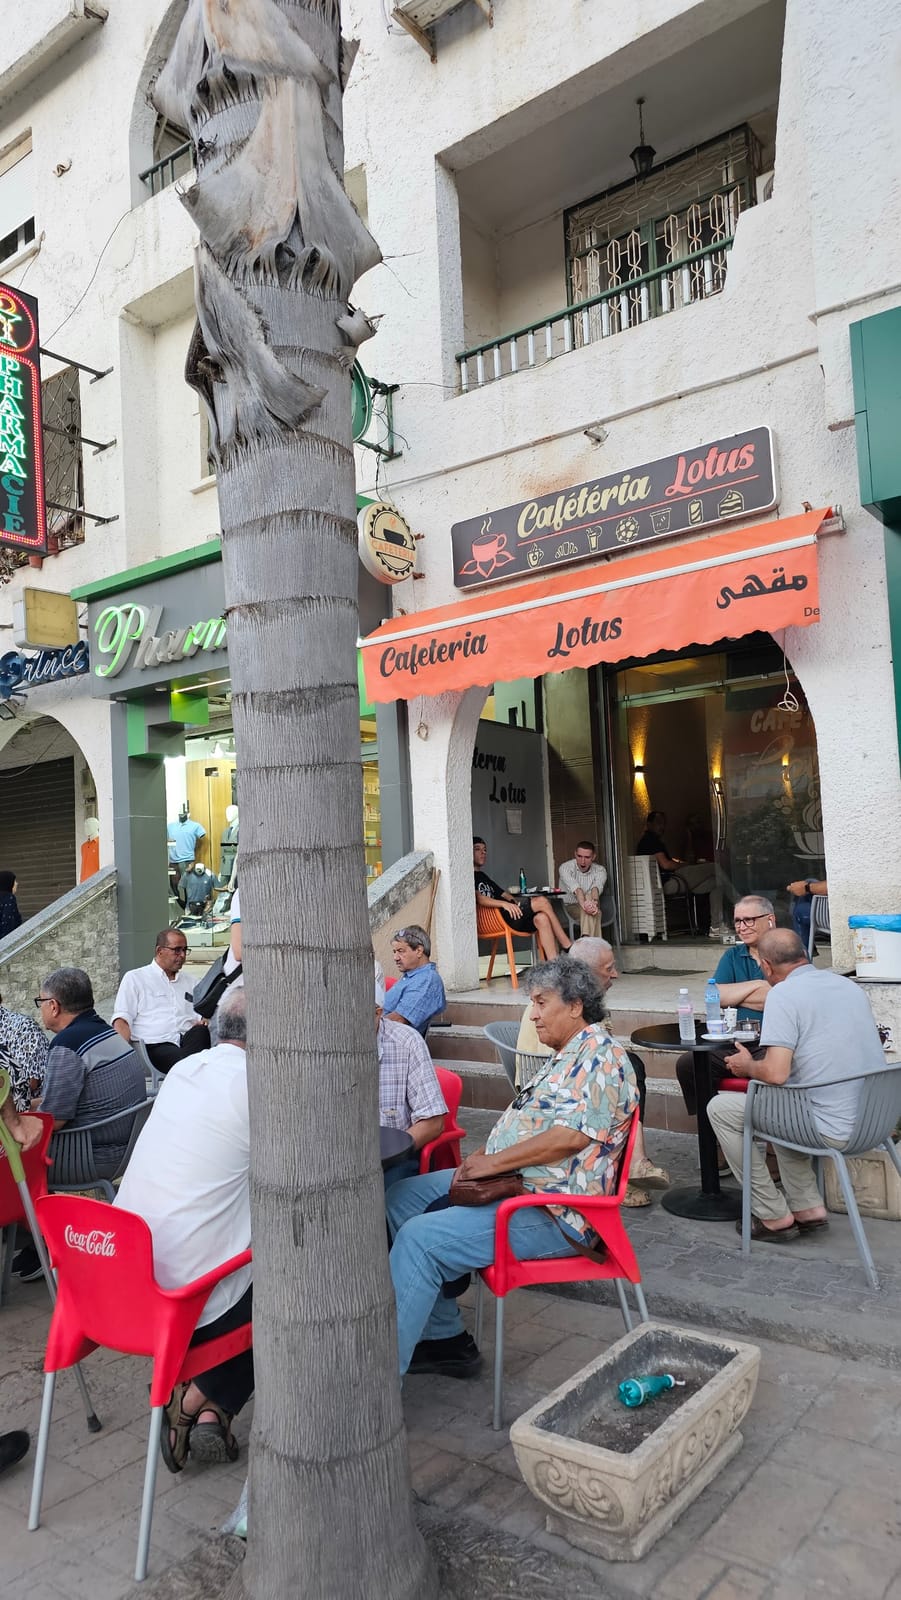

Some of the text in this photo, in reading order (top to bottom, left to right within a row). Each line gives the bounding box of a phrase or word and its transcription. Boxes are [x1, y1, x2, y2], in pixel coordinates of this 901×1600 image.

[0, 355, 27, 536] PHARMACIE
[517, 443, 756, 539] Cafétéria Lotus
[716, 567, 808, 610] مقهى
[380, 617, 623, 678] Cafeteria Lotus
[750, 708, 812, 734] CAFE
[489, 775, 527, 804] Lotus
[64, 1224, 116, 1257] Coca-Cola
